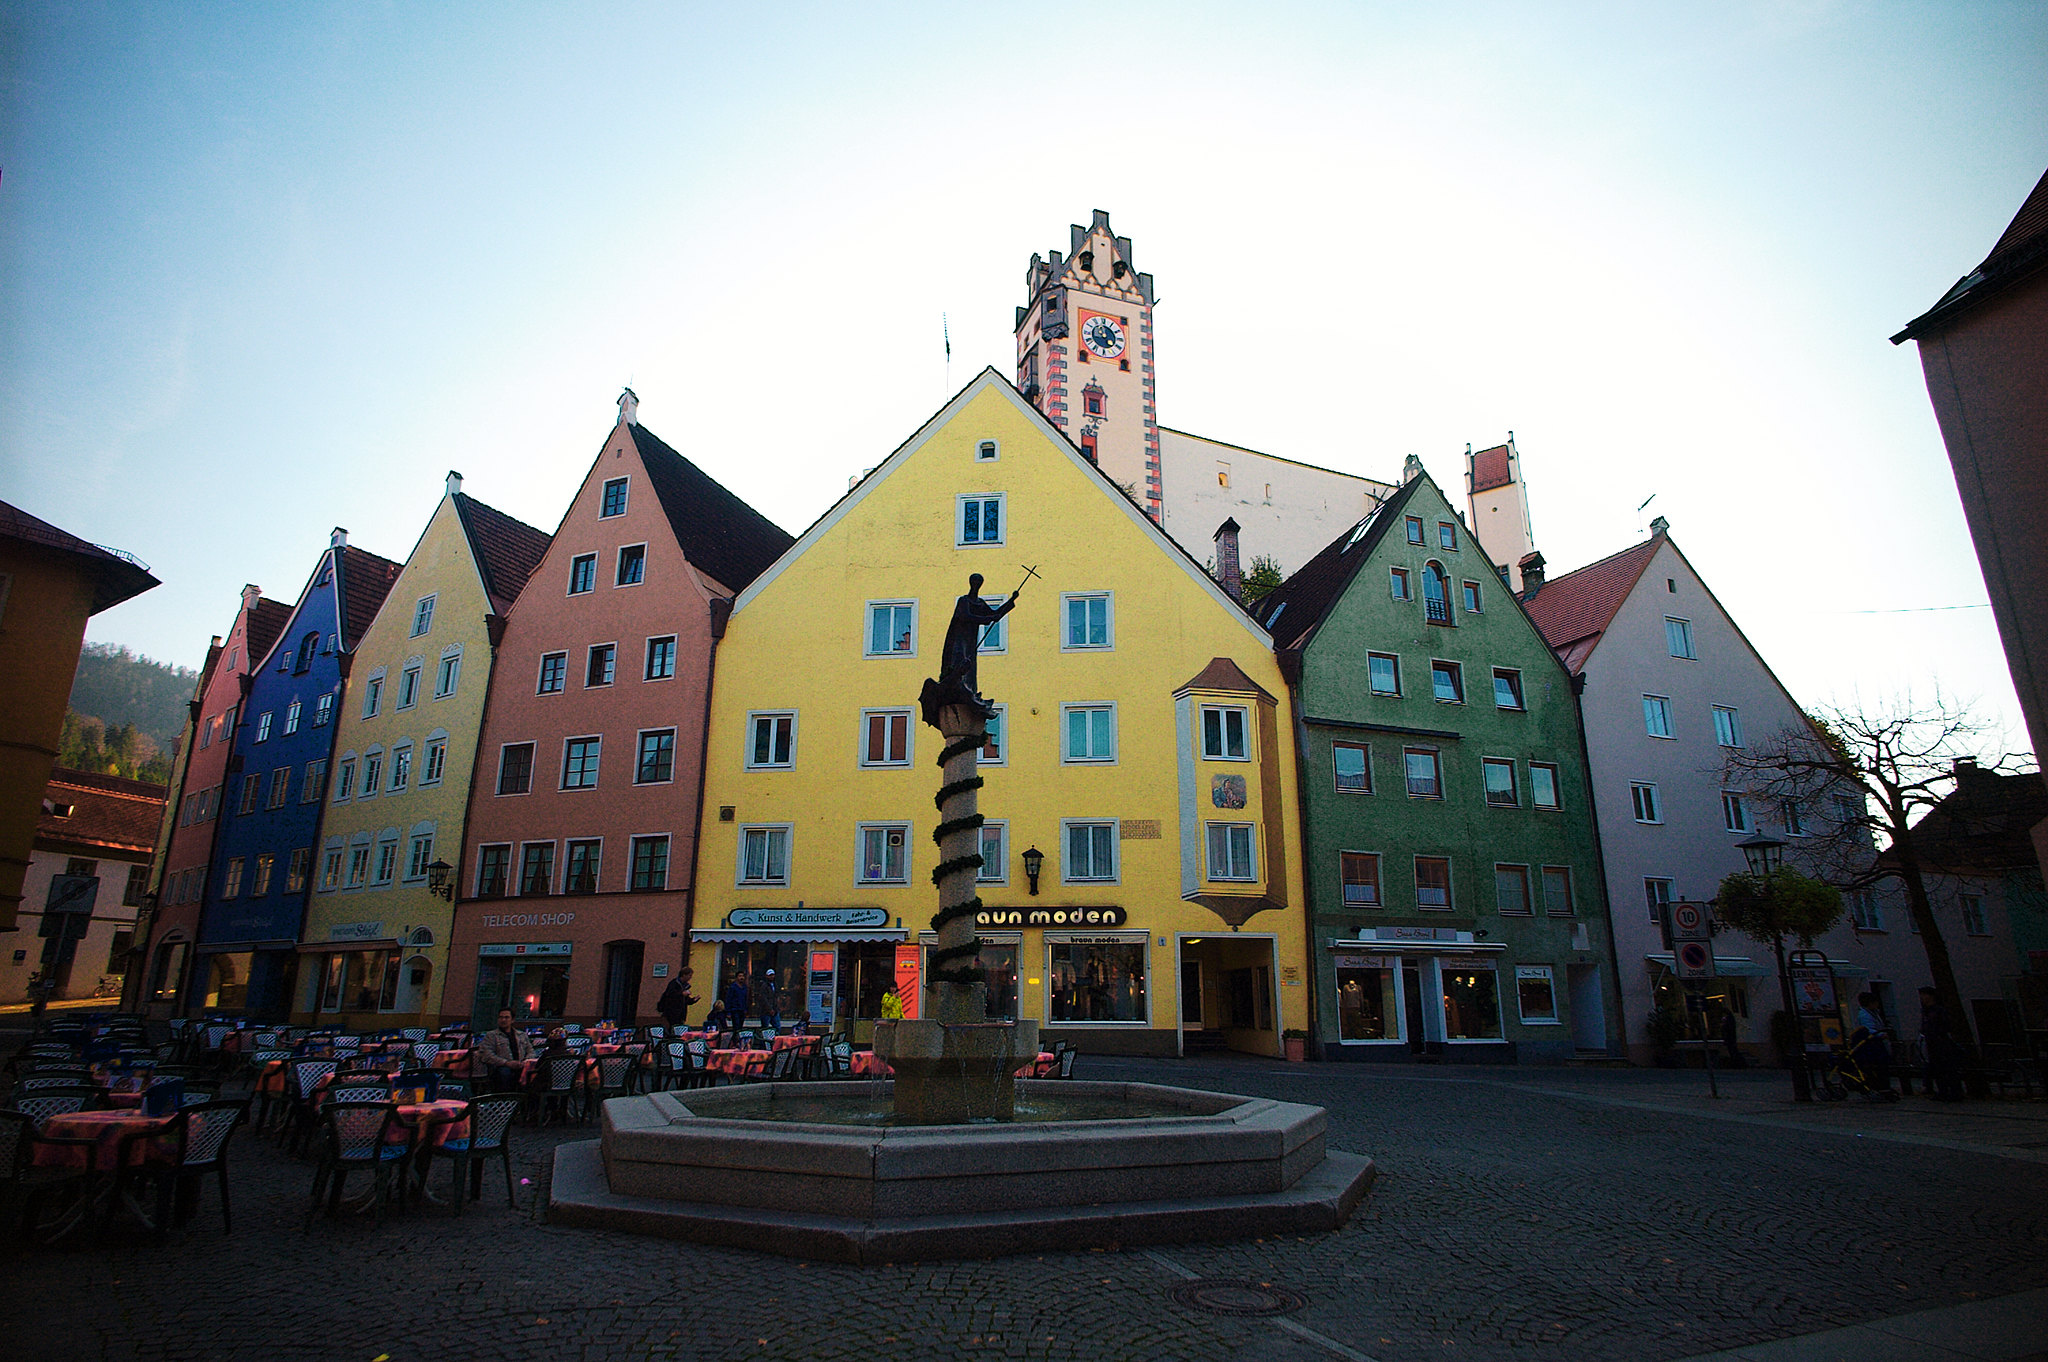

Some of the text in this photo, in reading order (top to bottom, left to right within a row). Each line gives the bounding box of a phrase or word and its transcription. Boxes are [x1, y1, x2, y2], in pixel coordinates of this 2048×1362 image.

[482, 912, 576, 927] TELECOM SHOP
[758, 913, 842, 923] Kunst & Handwerk
[976, 907, 1117, 925] aun moden
[1682, 911, 1695, 923] 10
[1070, 936, 1120, 944] braun moden
[1687, 969, 1706, 977] ZONE
